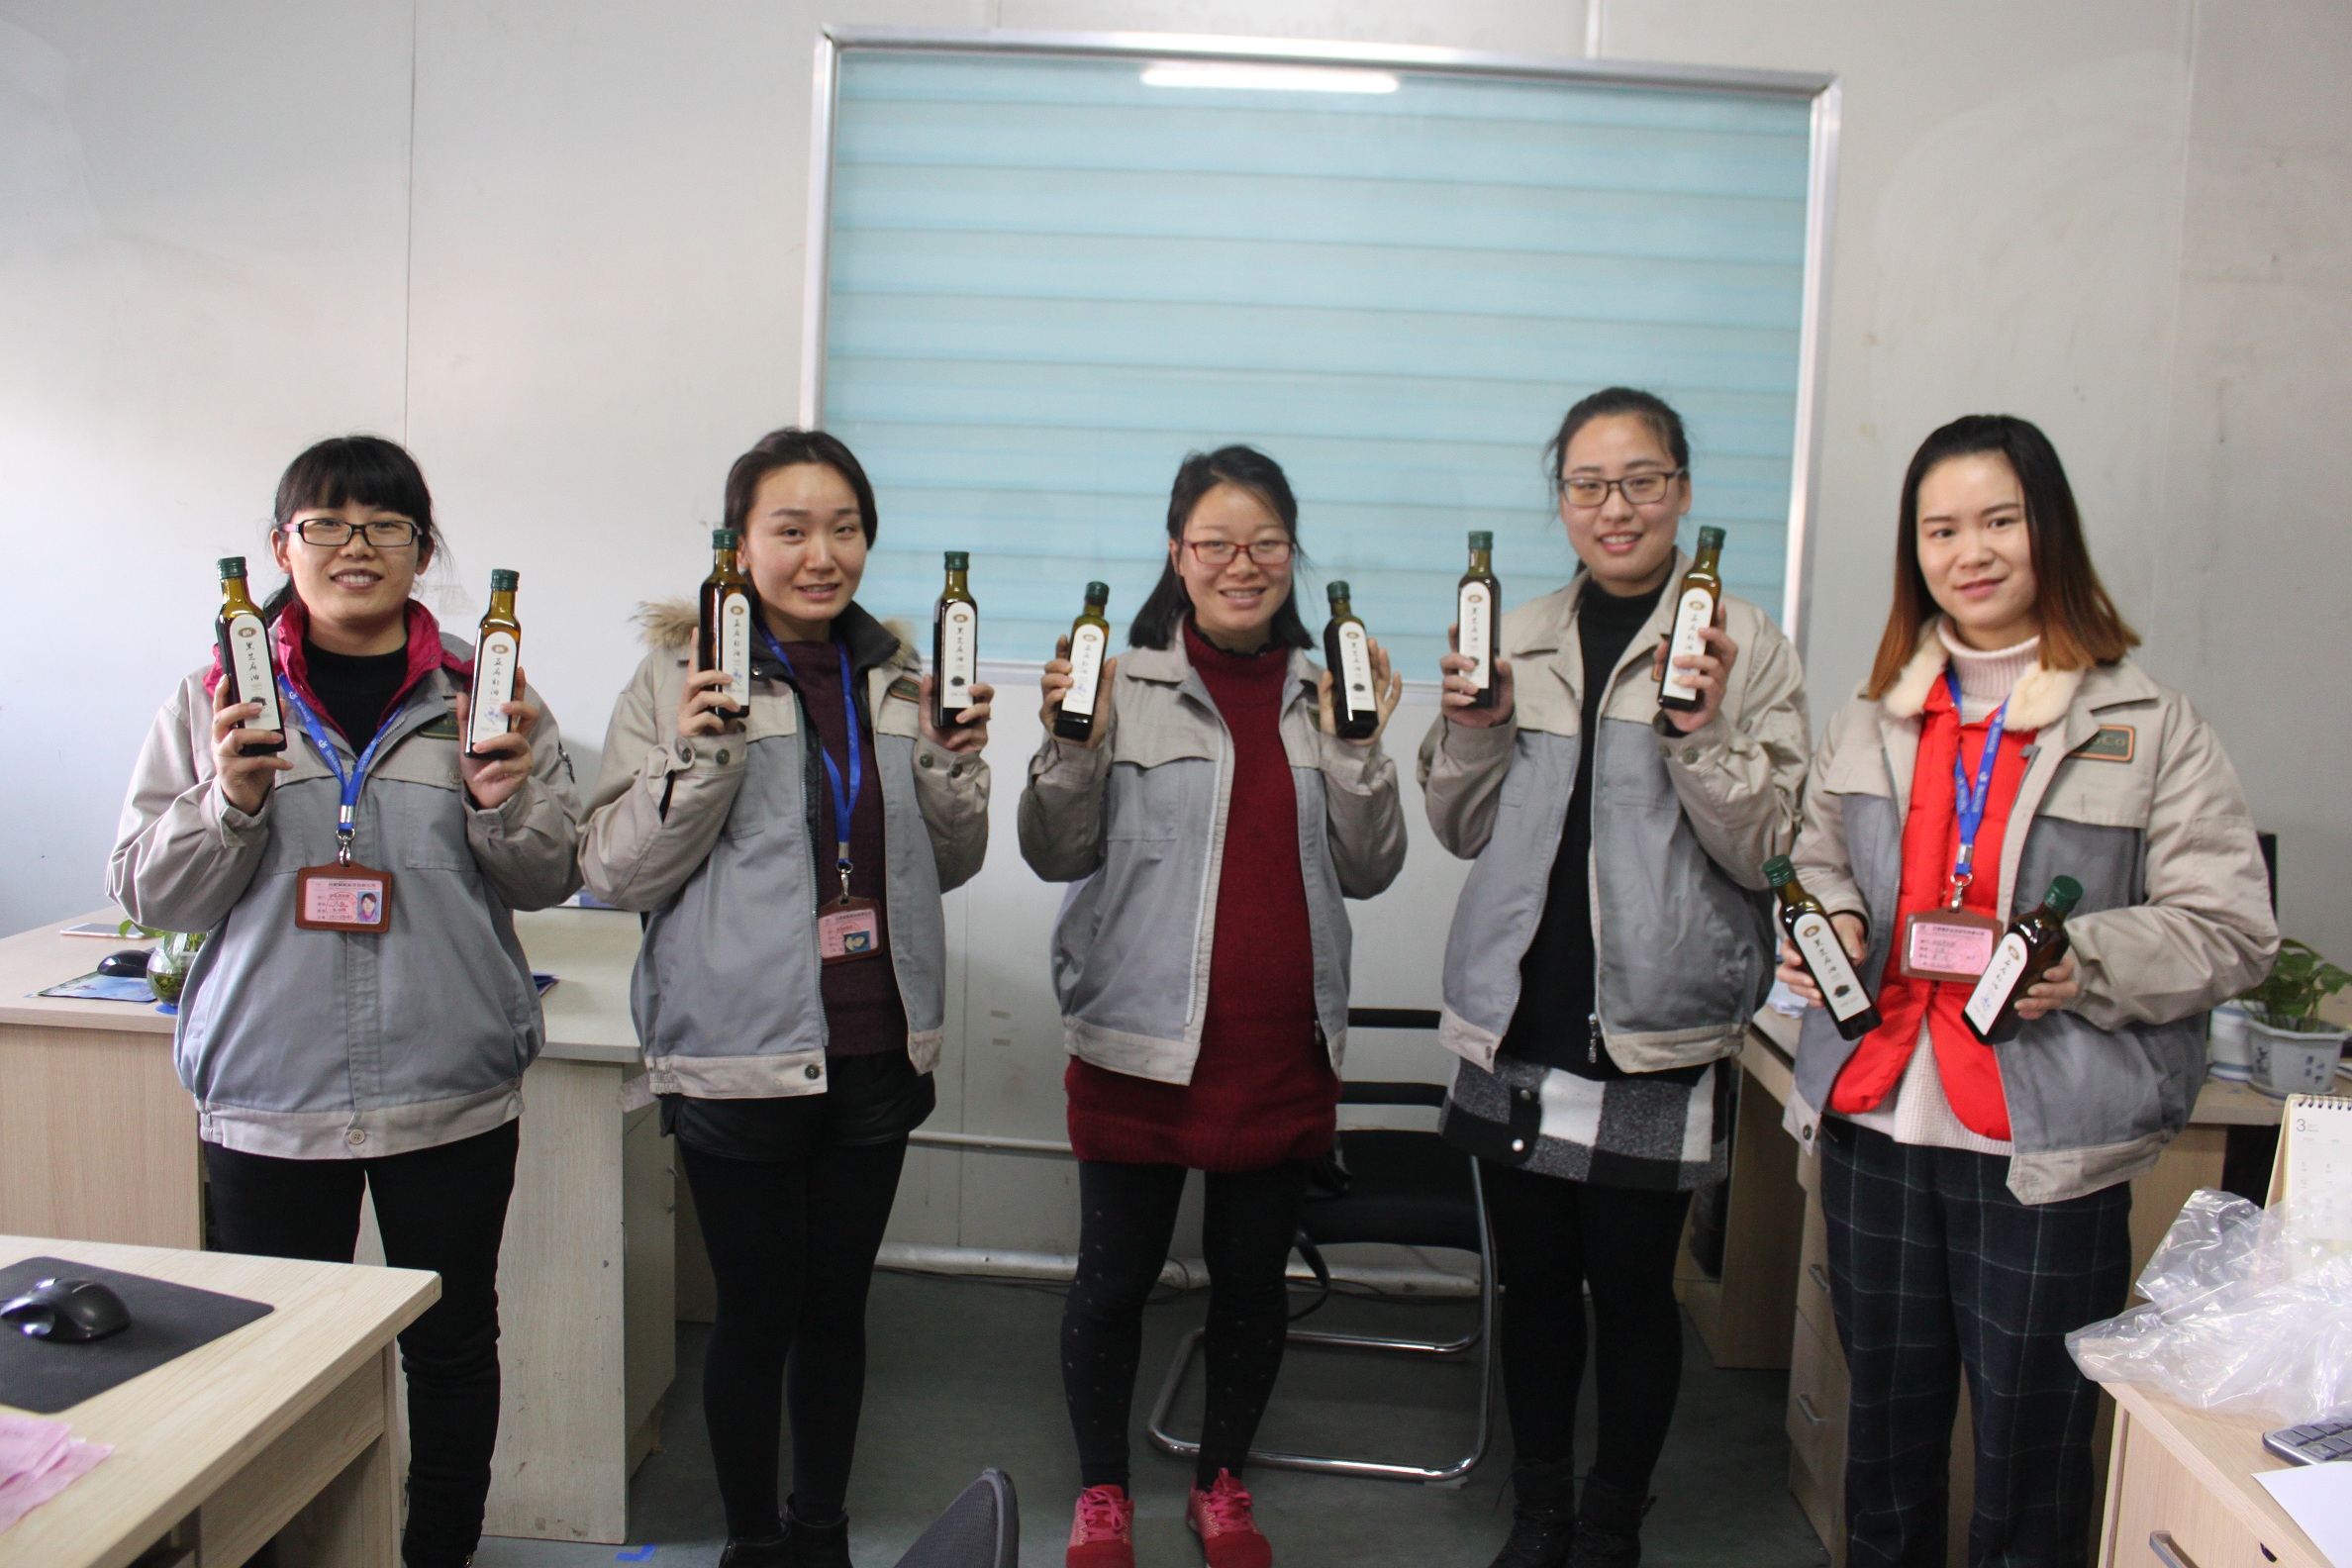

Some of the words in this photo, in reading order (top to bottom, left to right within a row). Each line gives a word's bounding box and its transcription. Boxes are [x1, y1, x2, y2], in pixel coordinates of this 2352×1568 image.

[245, 641, 259, 681] 黑芝麻油
[490, 657, 503, 697] 亚麻籽油
[2297, 1118, 2306, 1132] 3
